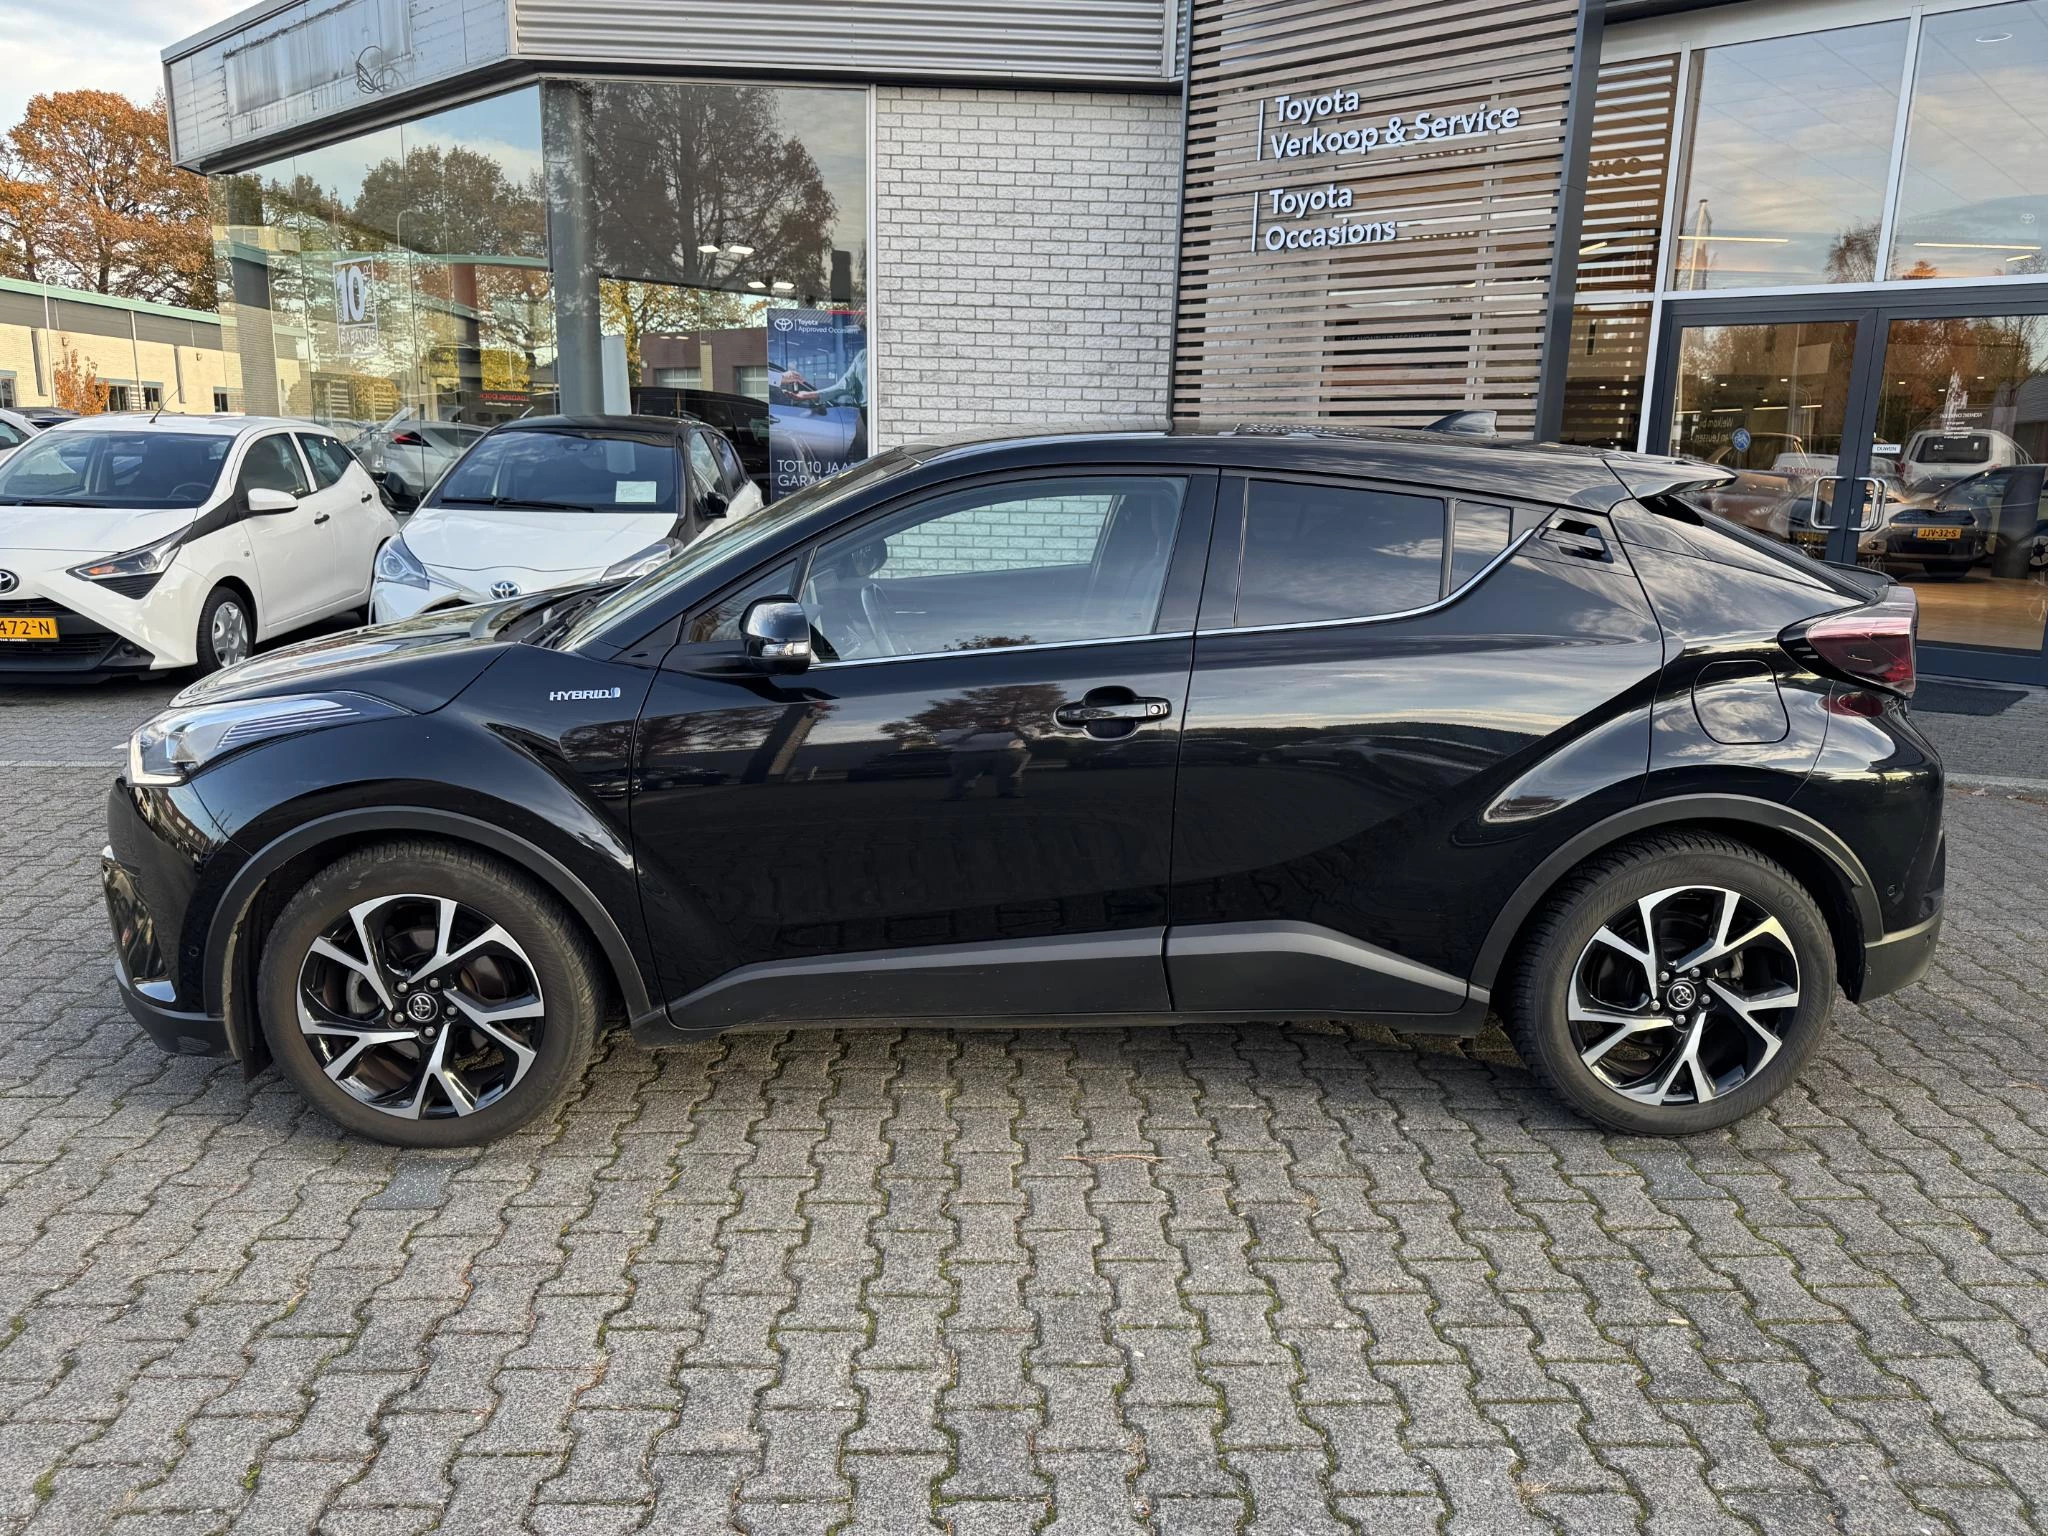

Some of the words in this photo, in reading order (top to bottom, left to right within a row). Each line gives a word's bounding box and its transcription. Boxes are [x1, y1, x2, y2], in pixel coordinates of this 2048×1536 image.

[1275, 88, 1360, 125] Toyota
[1271, 126, 1379, 159] Verkoop
[1385, 115, 1409, 144] &
[1414, 103, 1520, 141] Service
[1269, 183, 1353, 219] Toyota
[1265, 218, 1397, 252] Occasions
[336, 265, 366, 322] 10
[777, 459, 803, 473] TOT
[807, 460, 822, 474] 10
[777, 474, 823, 487] GARA
[0, 620, 51, 635] 472-N
[549, 689, 610, 701] HYBRID
